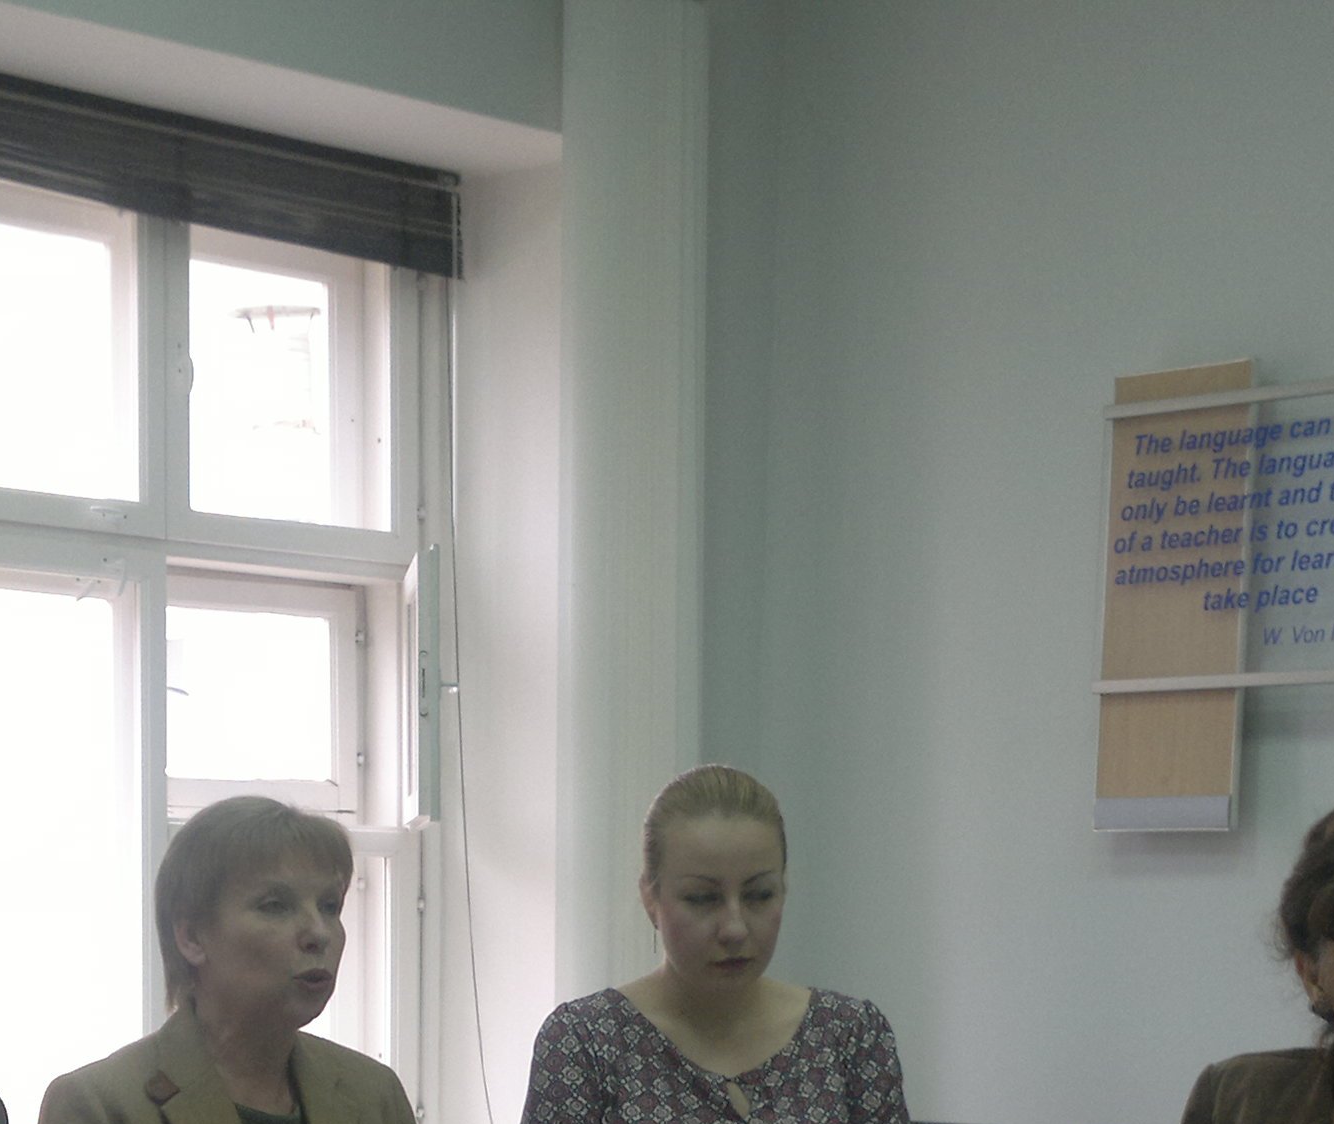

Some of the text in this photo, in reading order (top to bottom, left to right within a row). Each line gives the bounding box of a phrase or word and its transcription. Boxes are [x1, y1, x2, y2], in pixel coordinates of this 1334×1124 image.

[1134, 434, 1173, 456] The
[1178, 424, 1283, 454] language
[1289, 417, 1331, 440] can
[1126, 464, 1201, 491] taught.
[1211, 458, 1252, 481] The
[1120, 497, 1168, 524] only
[1173, 496, 1201, 518] be
[1207, 489, 1273, 513] learnt
[1278, 481, 1324, 507] and
[1113, 530, 1139, 555] of
[1140, 535, 1154, 553] a
[1160, 524, 1244, 551] teacher
[1249, 520, 1268, 543] is
[1276, 519, 1298, 540] to
[1114, 558, 1245, 586] atmosphere
[1251, 552, 1286, 575] for
[1202, 584, 1319, 613] take place
[1292, 624, 1326, 645] Von
